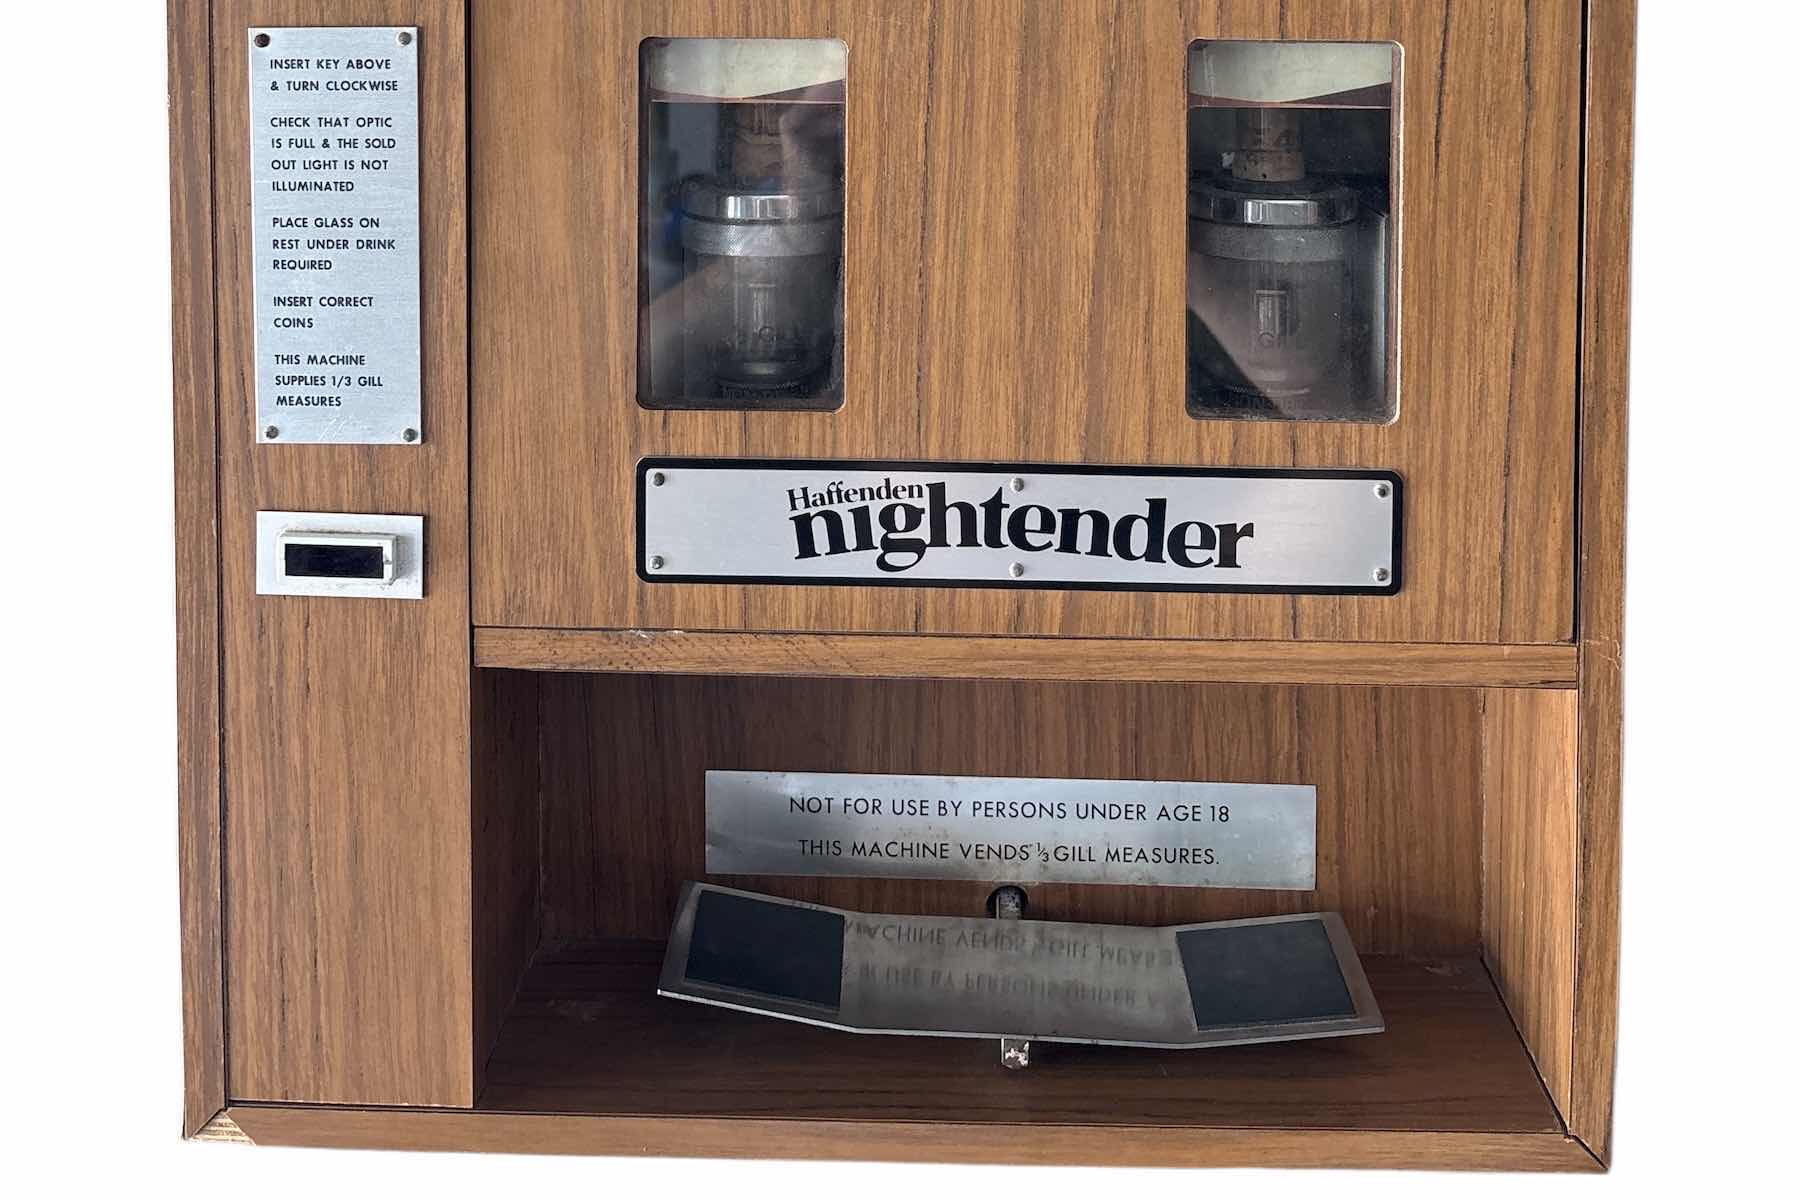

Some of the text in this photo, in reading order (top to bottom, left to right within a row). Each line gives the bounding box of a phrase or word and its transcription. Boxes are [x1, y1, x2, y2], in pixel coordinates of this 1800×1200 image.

[270, 59, 391, 69] INSERT KEY ABOVE
[271, 81, 398, 91] & TURN CLOCKWISE
[271, 117, 393, 128] CHECK THAT OPTIC
[272, 138, 396, 149] IS FULL & THE SOLD
[271, 160, 389, 170] OUT LIGHT IS NOT
[272, 181, 354, 192] ILLUMINATED
[272, 218, 380, 228] PLACE GLASS ON
[272, 239, 396, 250] REST UNDER DRINK
[273, 260, 332, 270] REQUIRED
[274, 297, 374, 307] INSERT CORRECT
[274, 318, 313, 328] COINS
[275, 355, 365, 365] THIS MACHINE
[275, 376, 383, 388] SUPPLIES 1/3 GILL
[276, 396, 342, 407] MEASURES
[786, 477, 925, 510] Haffenden
[787, 482, 1255, 573] nightender
[789, 797, 1230, 822] NOT FOR USE BY PERSONS UNDER AGE 18
[798, 840, 842, 856] THIS
[851, 841, 949, 859] MACHINE
[959, 843, 1030, 862] VENDS
[1054, 845, 1096, 862] GILL
[1105, 847, 1219, 864] MEASURES.
